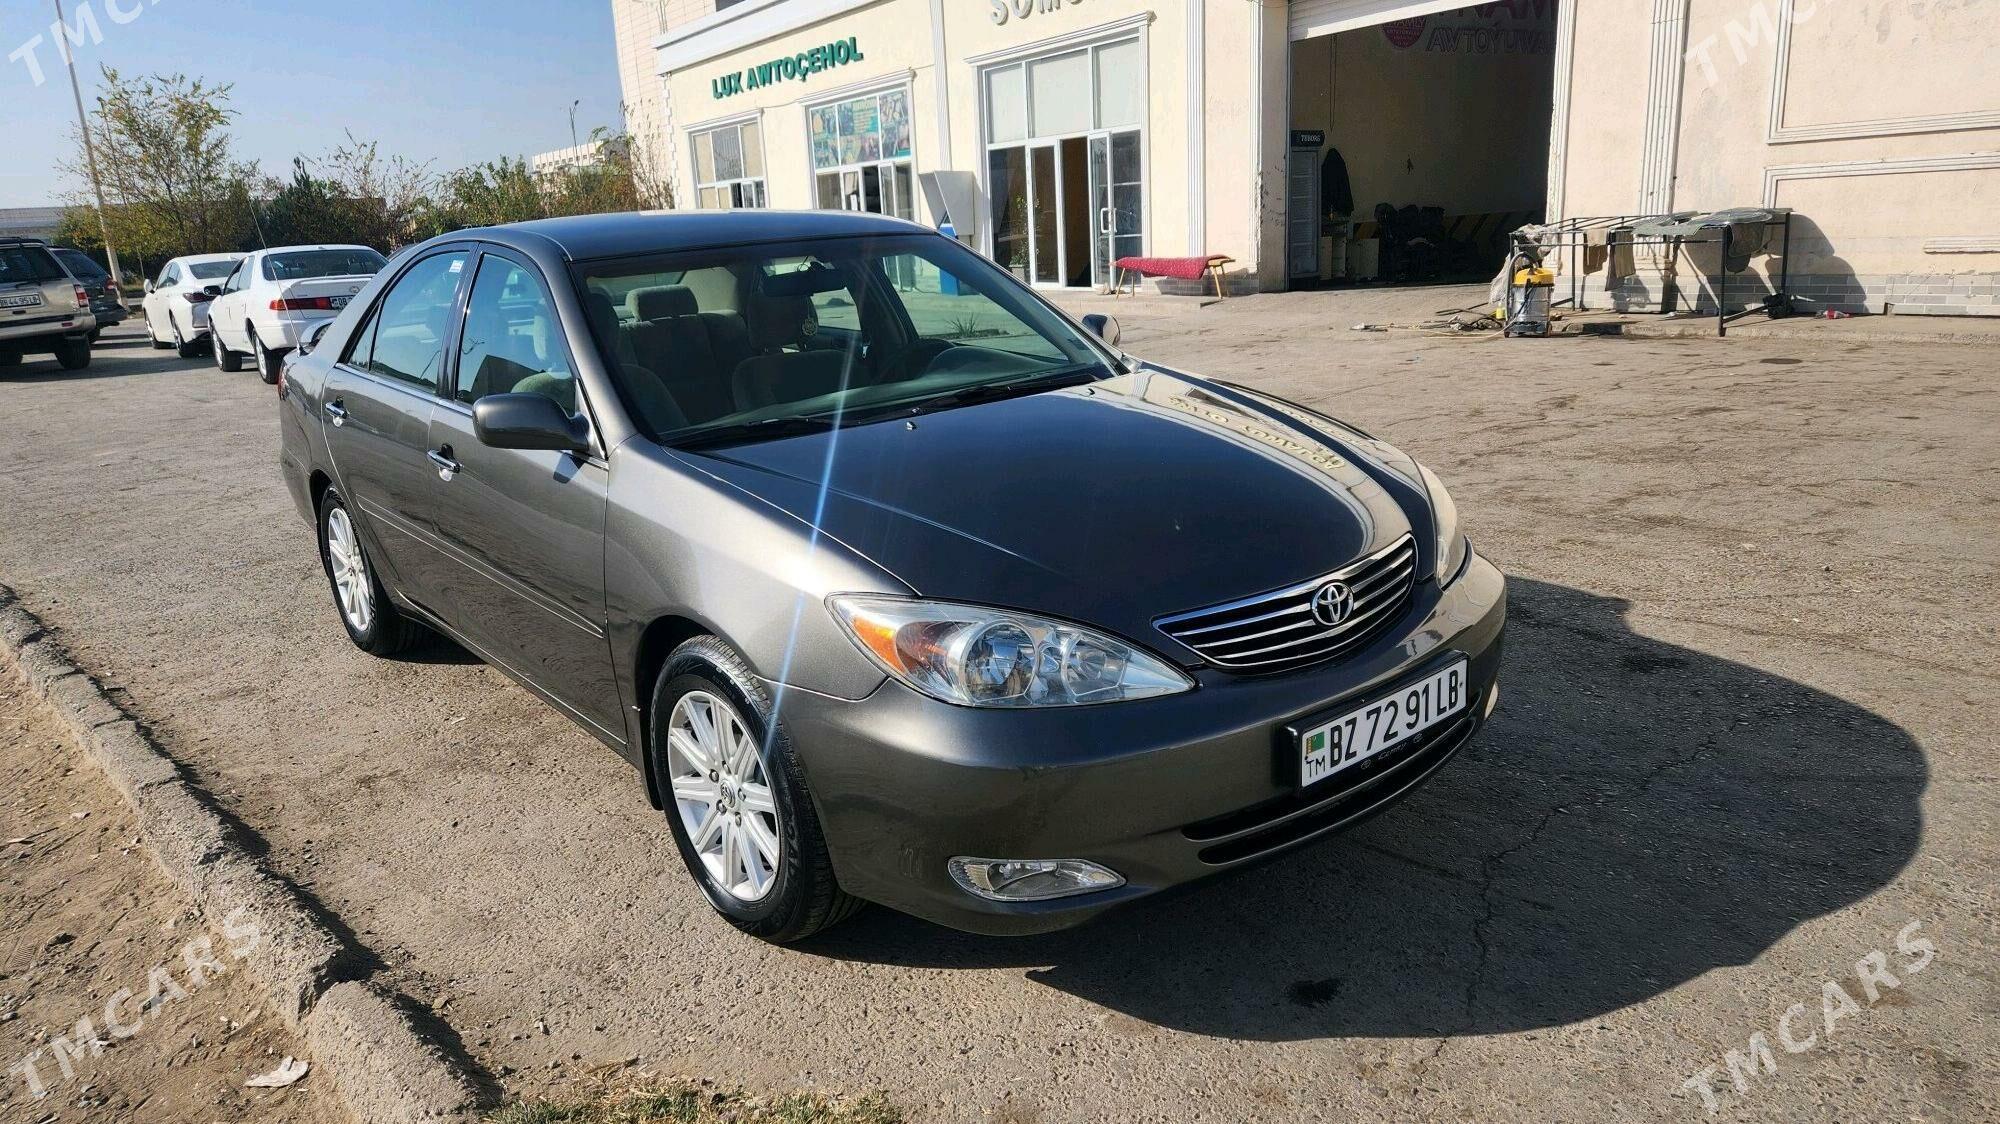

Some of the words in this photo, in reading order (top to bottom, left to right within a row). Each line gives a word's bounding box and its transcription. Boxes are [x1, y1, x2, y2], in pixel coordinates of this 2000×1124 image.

[712, 71, 744, 99] LUX
[746, 36, 864, 82] AWTOÇEHOL
[1330, 716, 1358, 769] BZ
[1366, 700, 1399, 751] 72
[1405, 683, 1430, 730] 91
[1437, 669, 1459, 717] LB
[1306, 755, 1326, 778] TM
